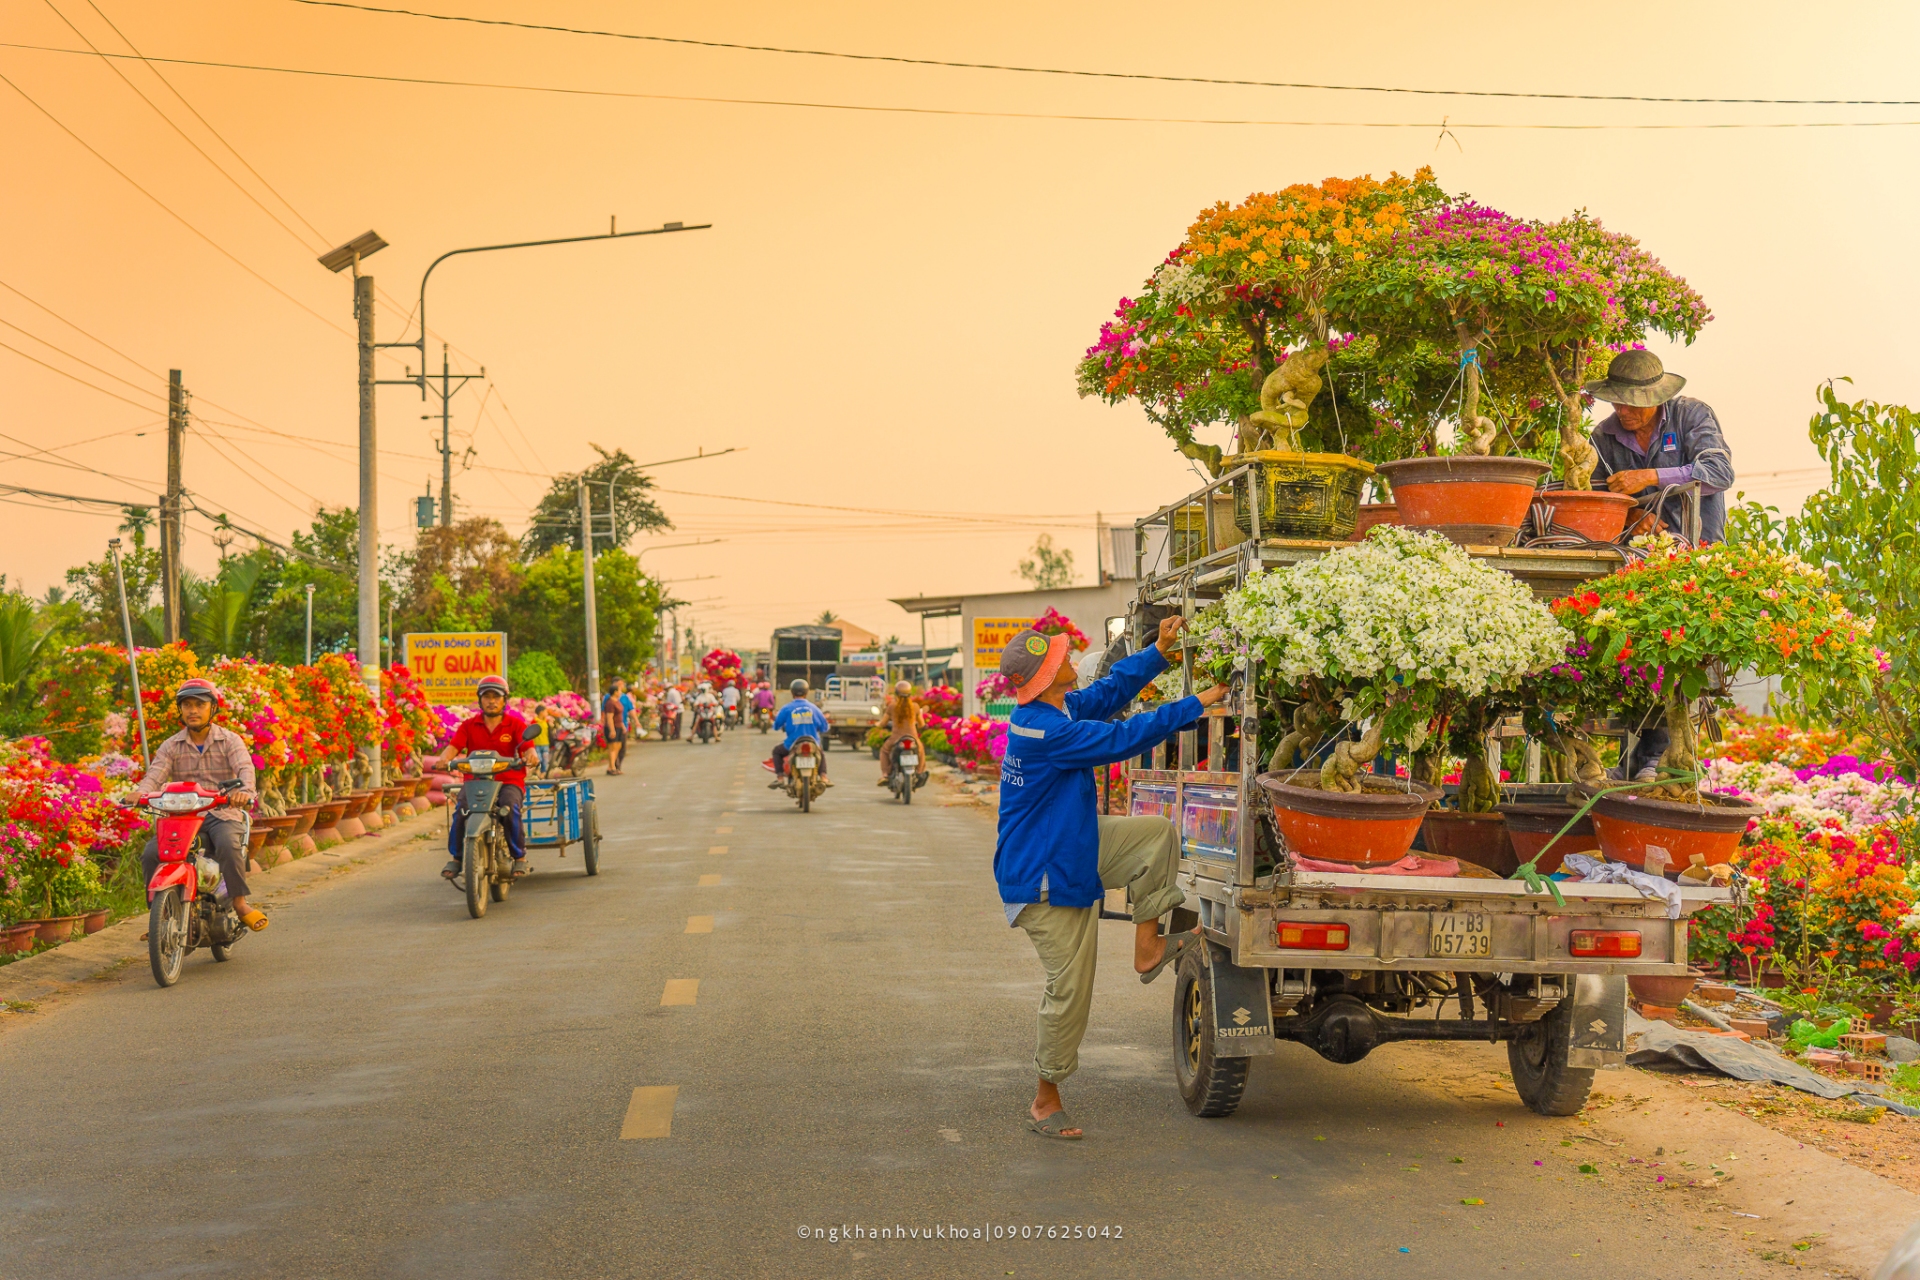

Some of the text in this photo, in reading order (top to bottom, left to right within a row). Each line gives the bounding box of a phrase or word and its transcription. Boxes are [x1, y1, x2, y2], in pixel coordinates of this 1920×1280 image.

[444, 637, 471, 648] BÔNG
[414, 650, 497, 673] TƯ QUÂN
[1433, 933, 1489, 955] 057.39
[1218, 1025, 1268, 1037] SUZUKI
